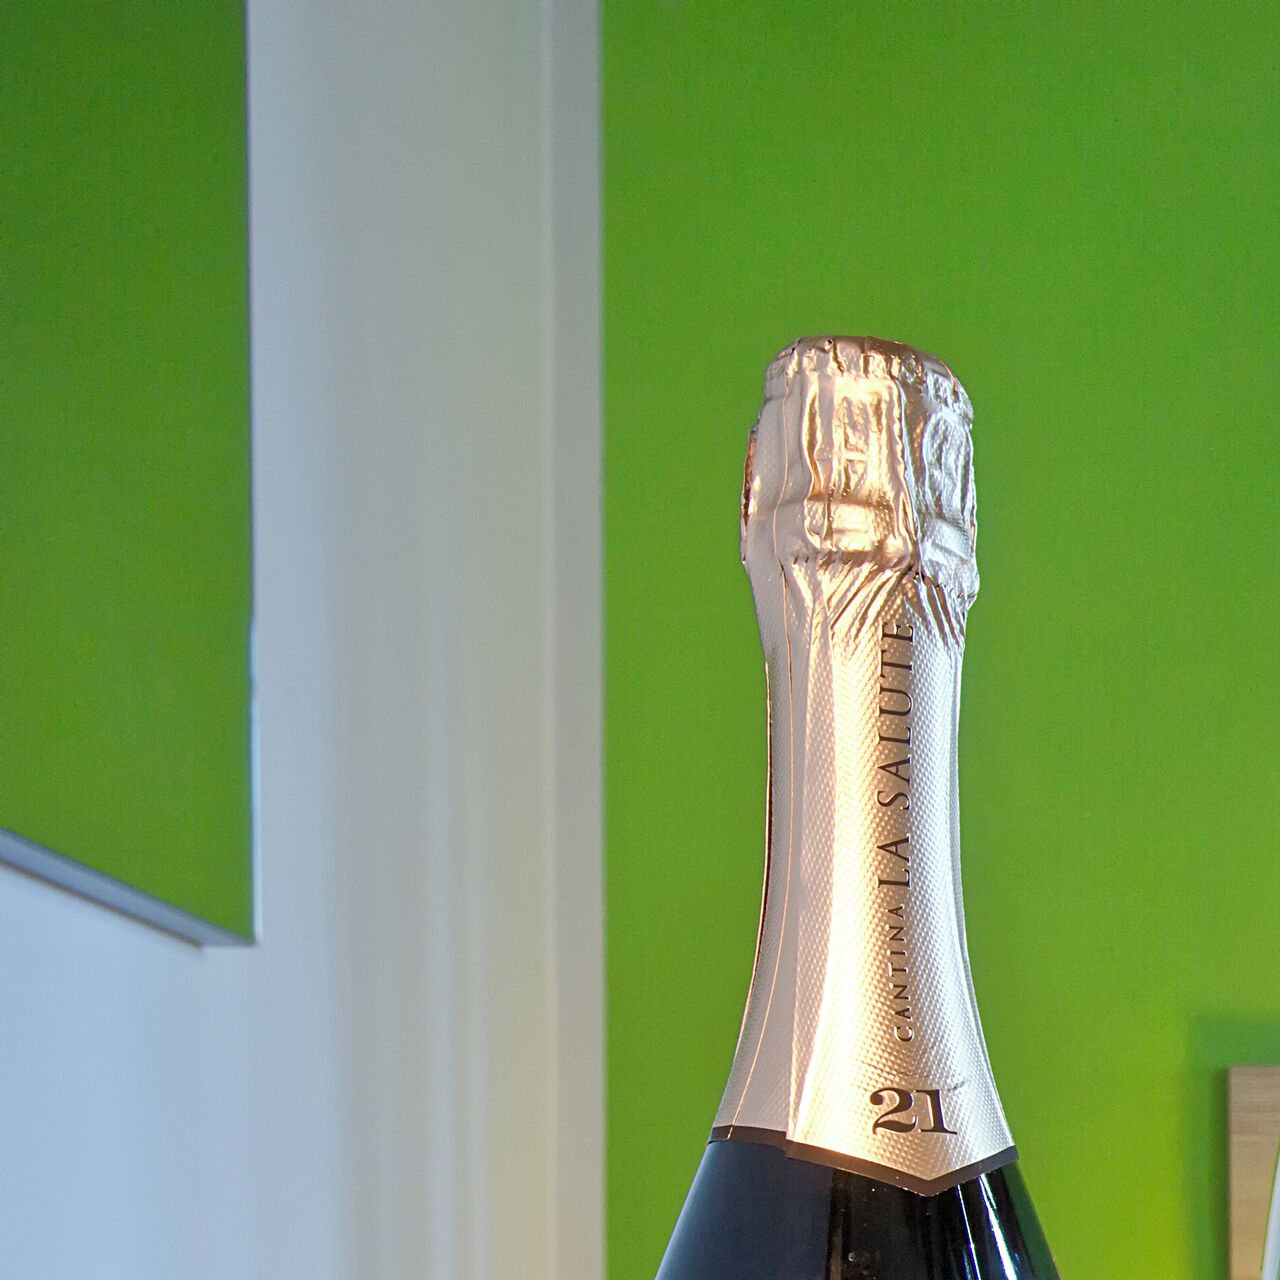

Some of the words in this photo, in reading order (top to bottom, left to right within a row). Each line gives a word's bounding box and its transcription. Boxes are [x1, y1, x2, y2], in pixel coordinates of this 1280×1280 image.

[877, 620, 915, 812] SALUTE
[877, 832, 911, 891] LA
[886, 902, 913, 1043] CANTINA
[870, 1086, 957, 1137] 21
